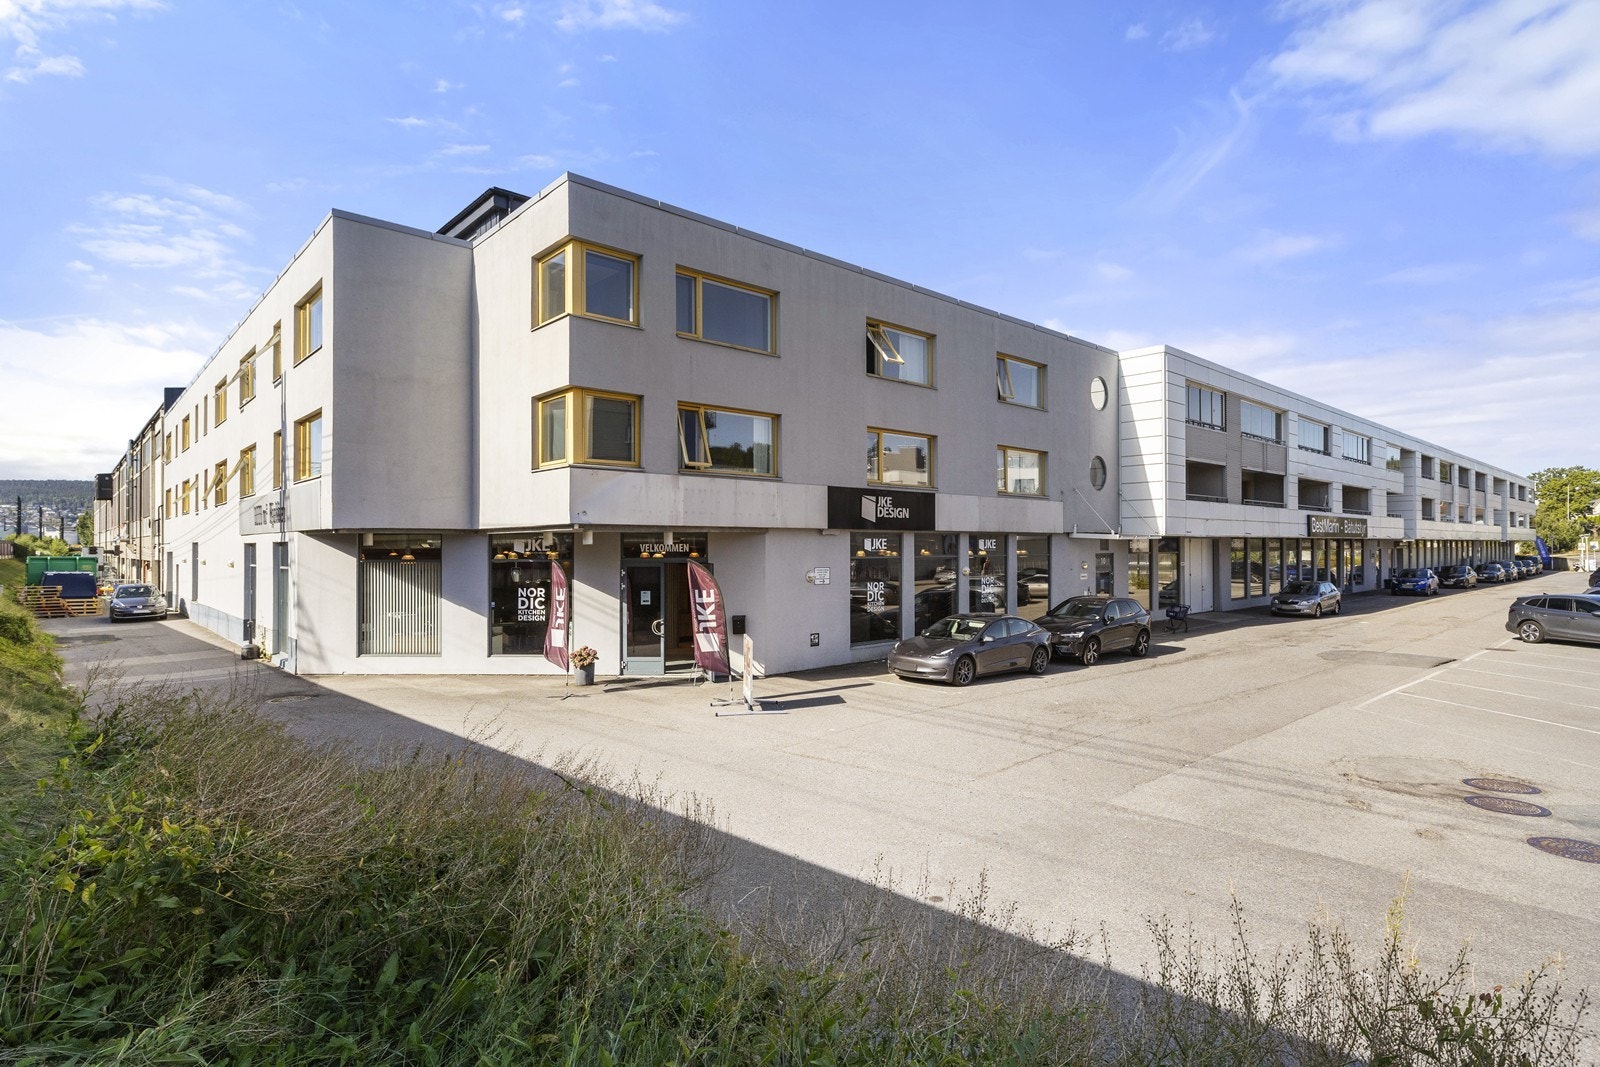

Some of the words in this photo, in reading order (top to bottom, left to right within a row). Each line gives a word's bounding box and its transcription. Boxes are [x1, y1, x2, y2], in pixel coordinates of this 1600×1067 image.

[878, 496, 892, 507] JKE
[877, 507, 909, 519] DESIGN
[1311, 517, 1339, 533] BestMarin
[640, 543, 689, 552] VELKOMMEN
[871, 538, 887, 549] JKE
[984, 539, 996, 549] JKE
[867, 581, 885, 591] NOR
[518, 587, 545, 597] NOR
[867, 590, 885, 602] DIC
[518, 597, 545, 609] DIC
[555, 587, 566, 628] JKE
[695, 589, 717, 632] JKE
